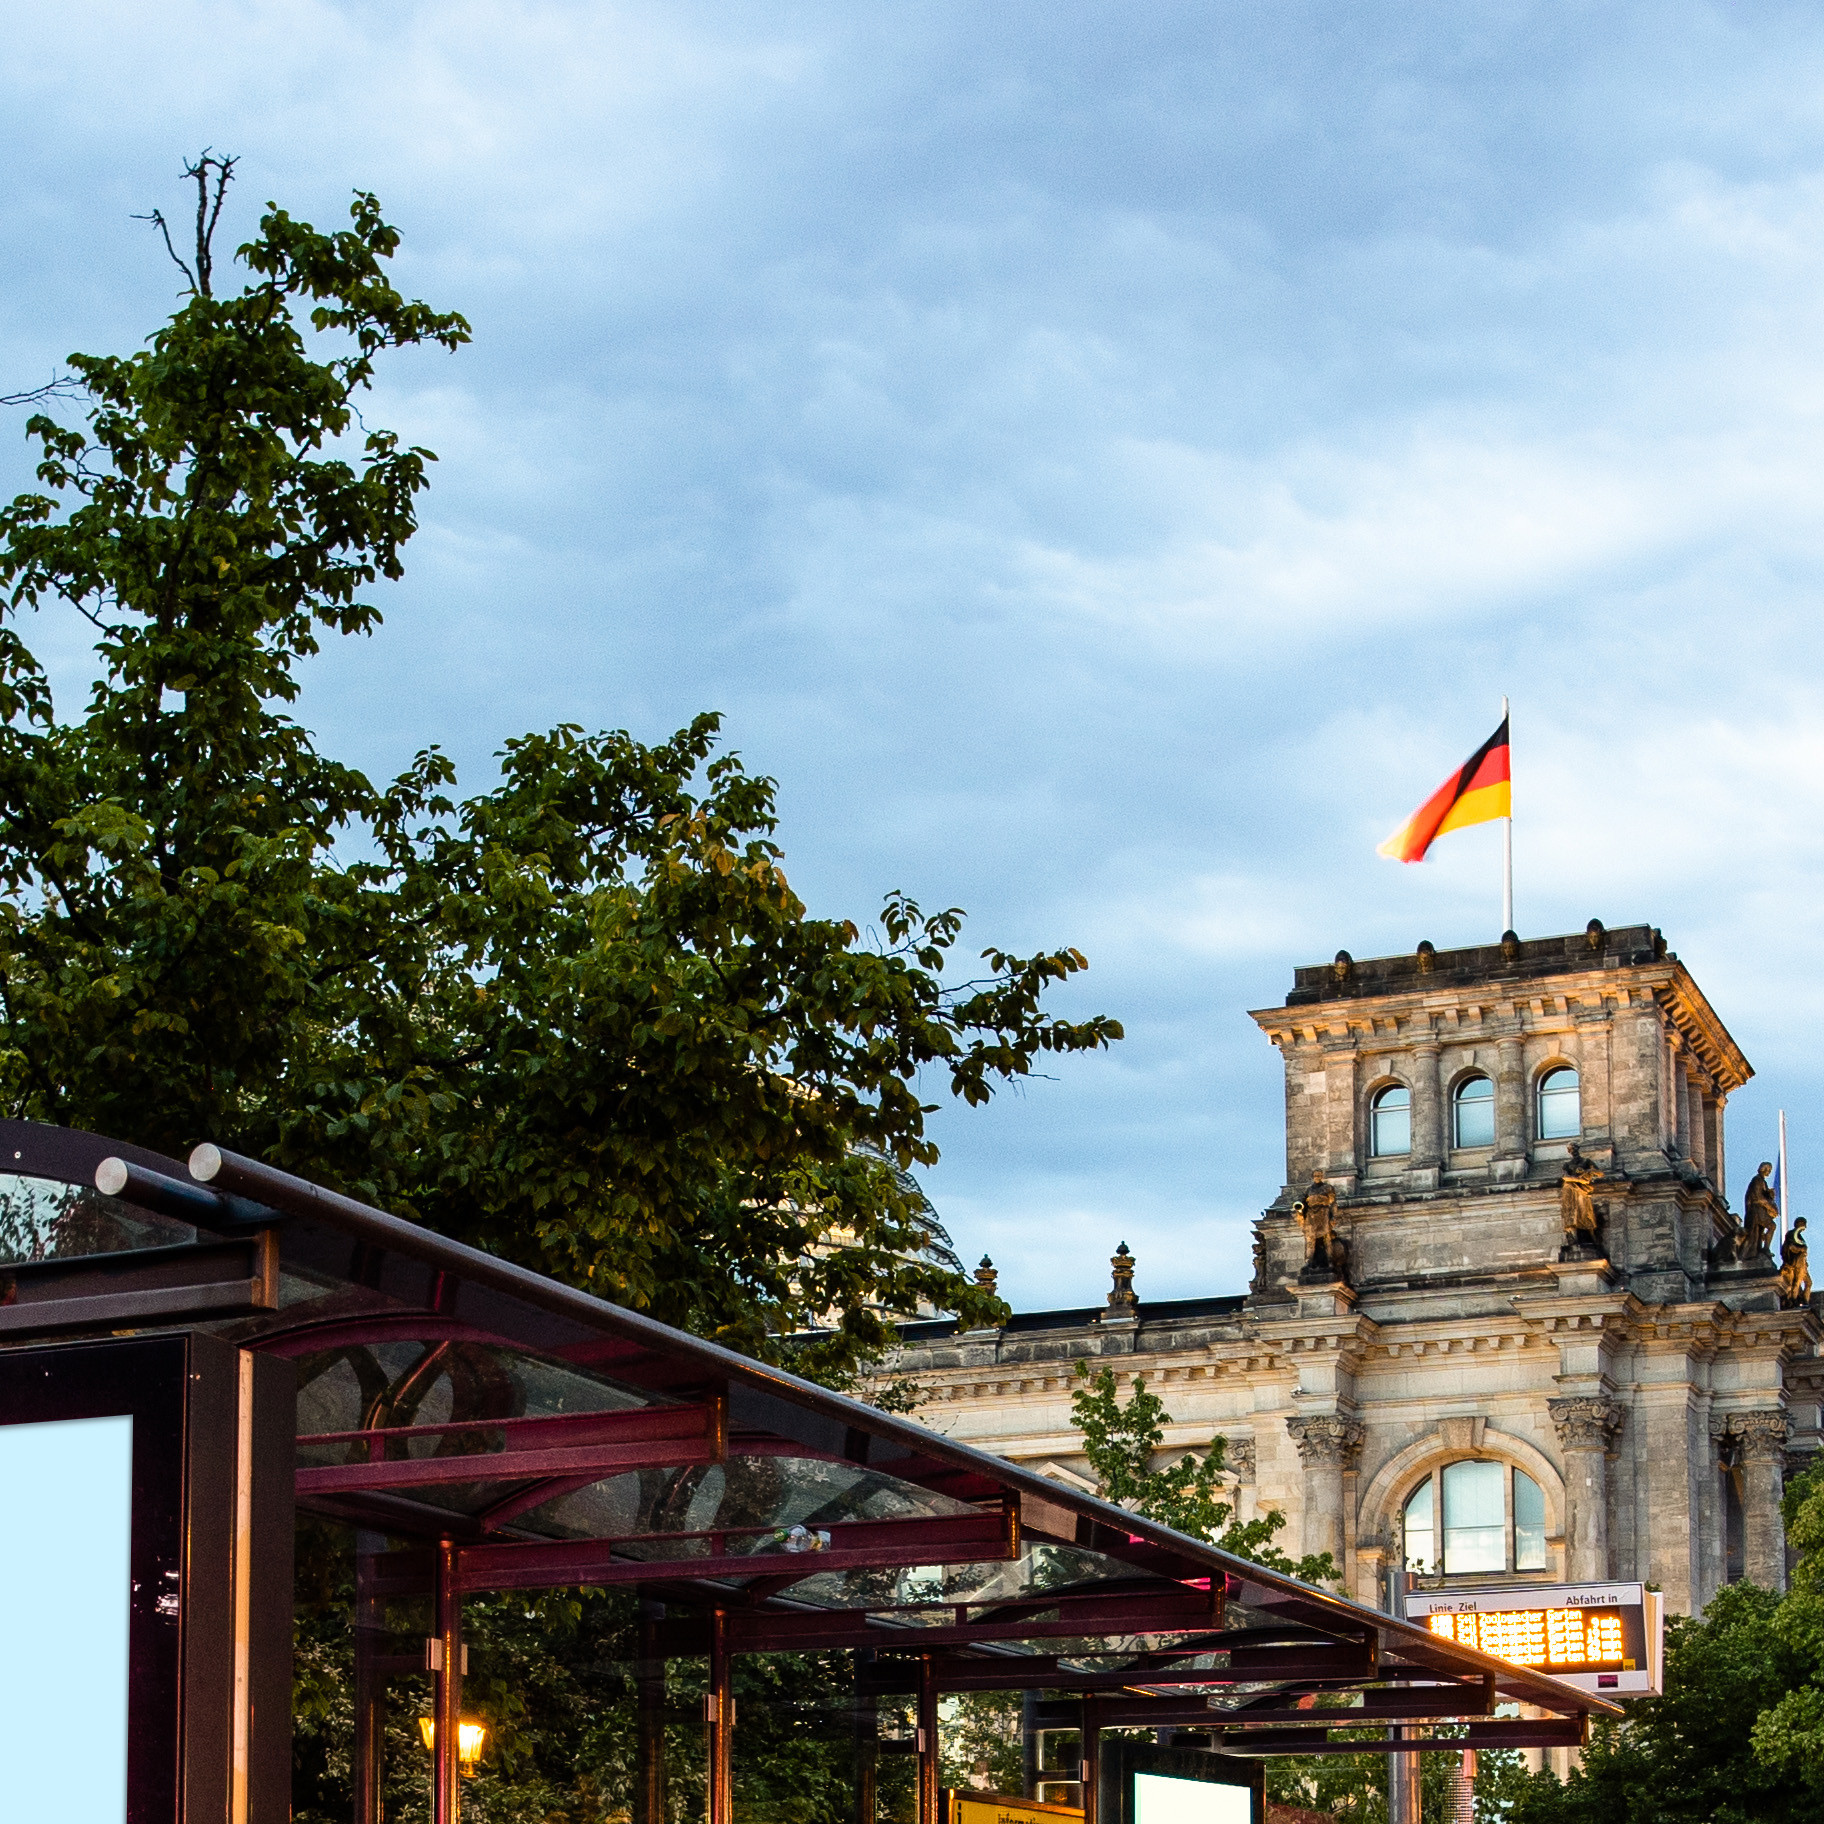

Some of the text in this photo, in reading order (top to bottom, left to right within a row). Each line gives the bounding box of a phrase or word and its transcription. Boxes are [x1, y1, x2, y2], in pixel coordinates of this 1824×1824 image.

[1566, 1594, 1618, 1605] Abfahrt in
[1429, 1602, 1477, 1613] Linie Ziel
[1478, 1611, 1543, 1623] Zoologischer
[1546, 1609, 1582, 1620] Garten
